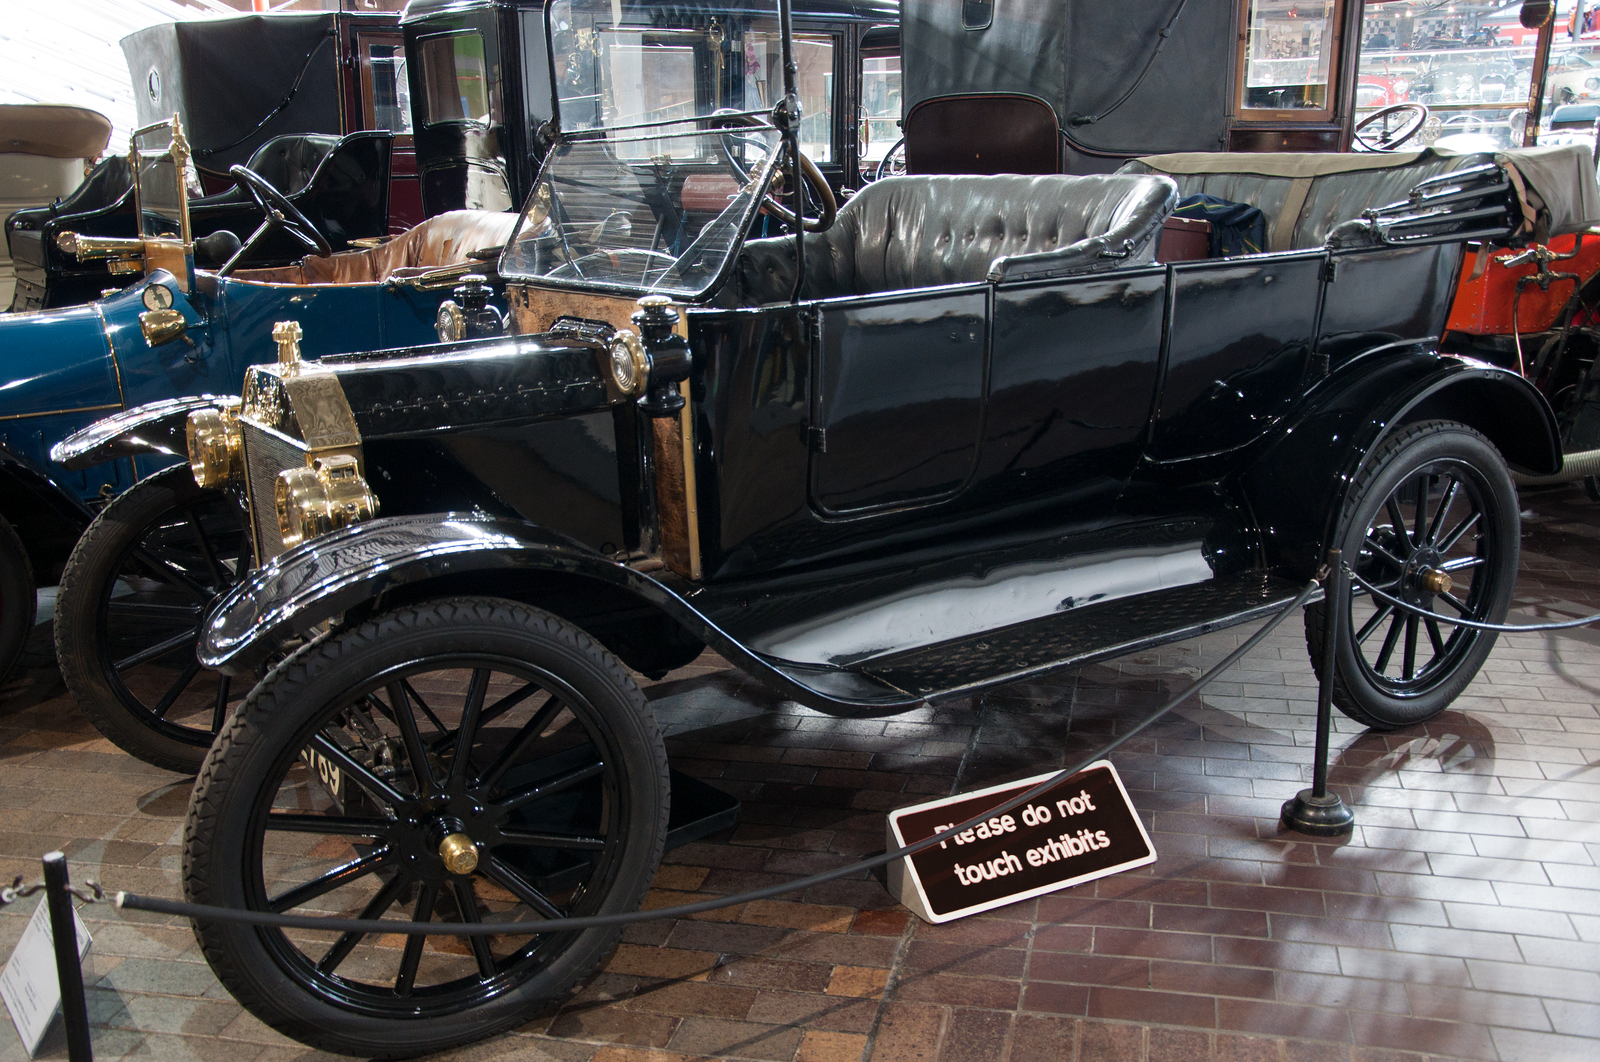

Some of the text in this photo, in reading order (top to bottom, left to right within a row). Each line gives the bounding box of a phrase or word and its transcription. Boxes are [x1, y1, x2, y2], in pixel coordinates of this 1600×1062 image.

[934, 790, 1096, 849] Please do not
[954, 829, 1110, 885] touch exhibits
